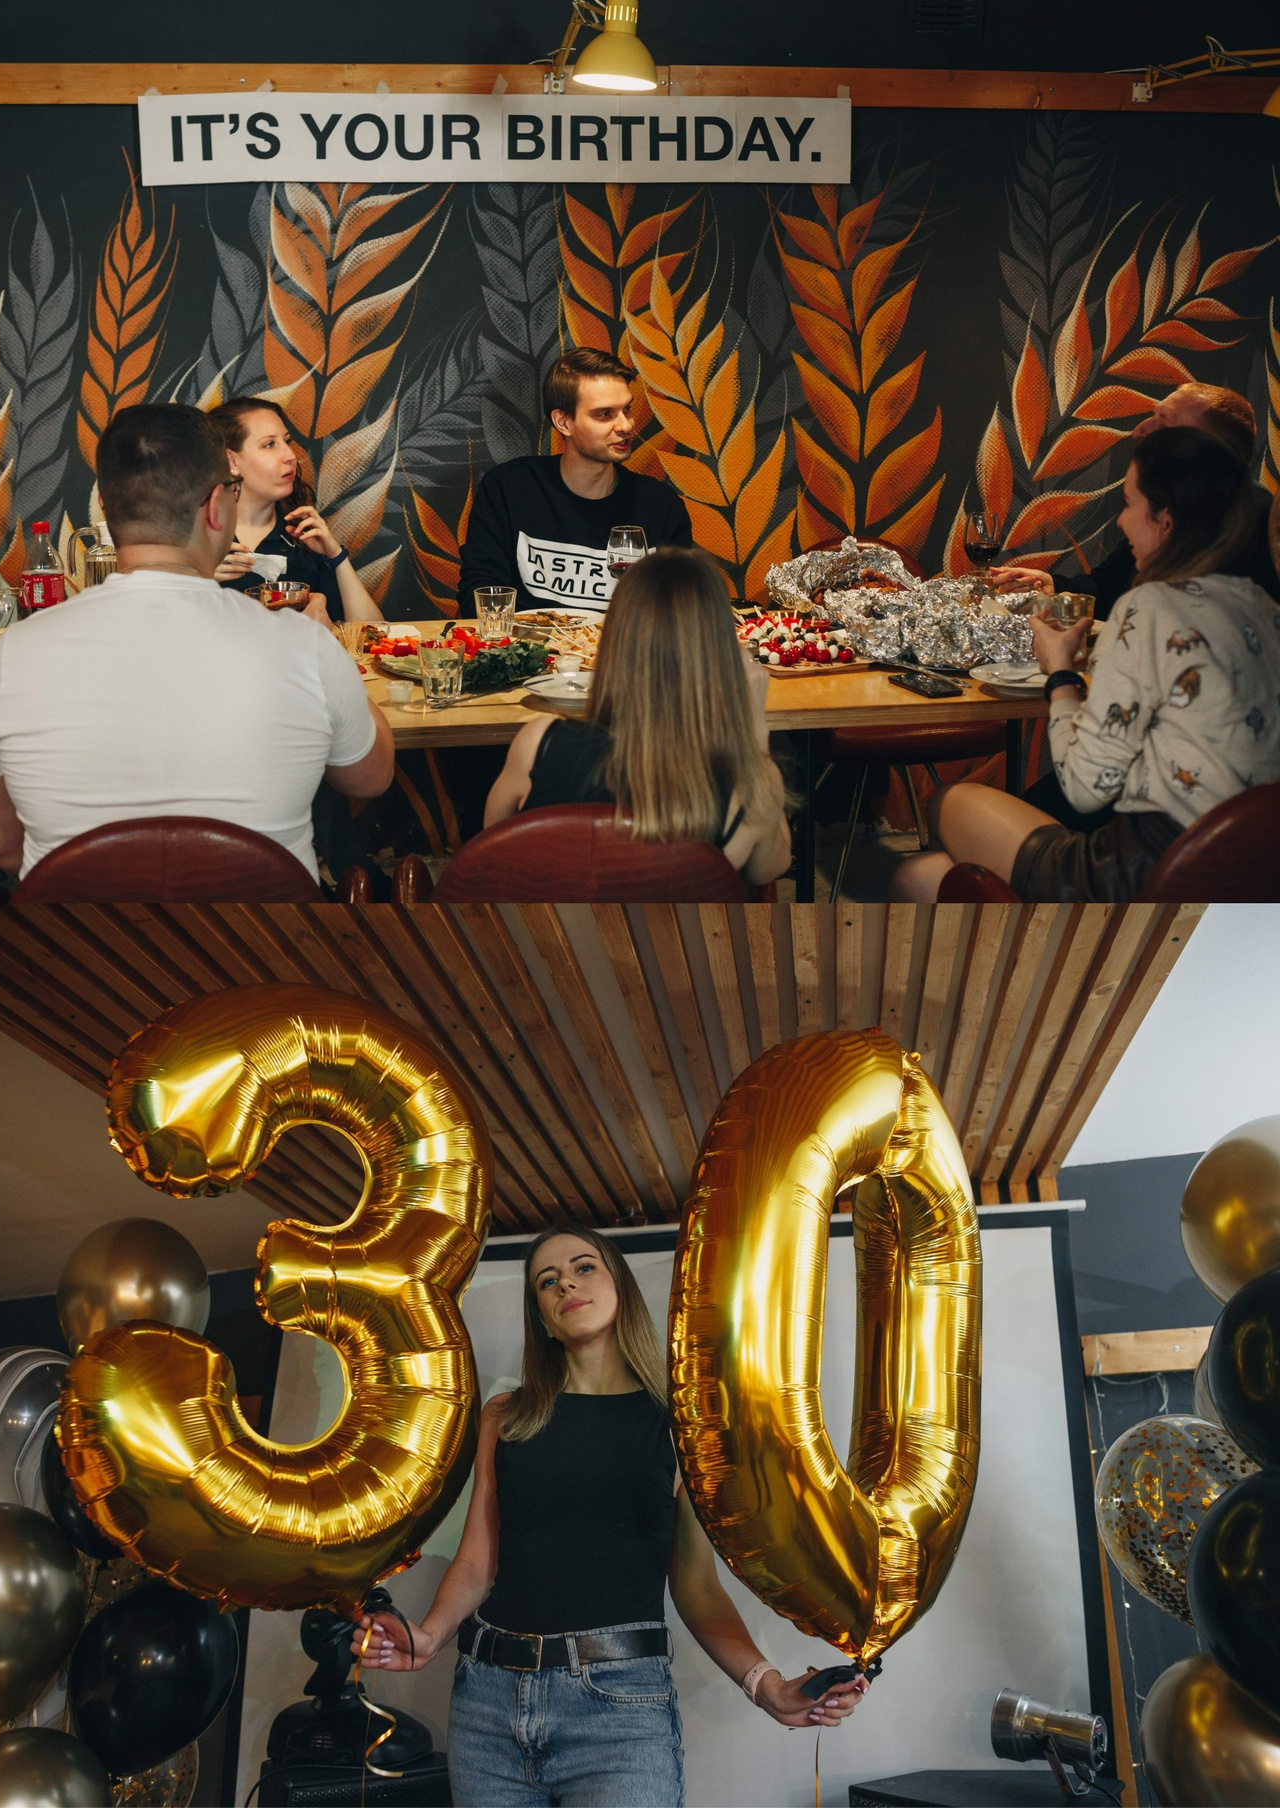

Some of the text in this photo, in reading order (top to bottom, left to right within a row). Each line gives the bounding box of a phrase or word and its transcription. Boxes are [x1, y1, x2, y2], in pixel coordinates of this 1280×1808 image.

[170, 111, 822, 163] IT’S YOUR BIRTHDAY.
[529, 553, 618, 579] ASTR
